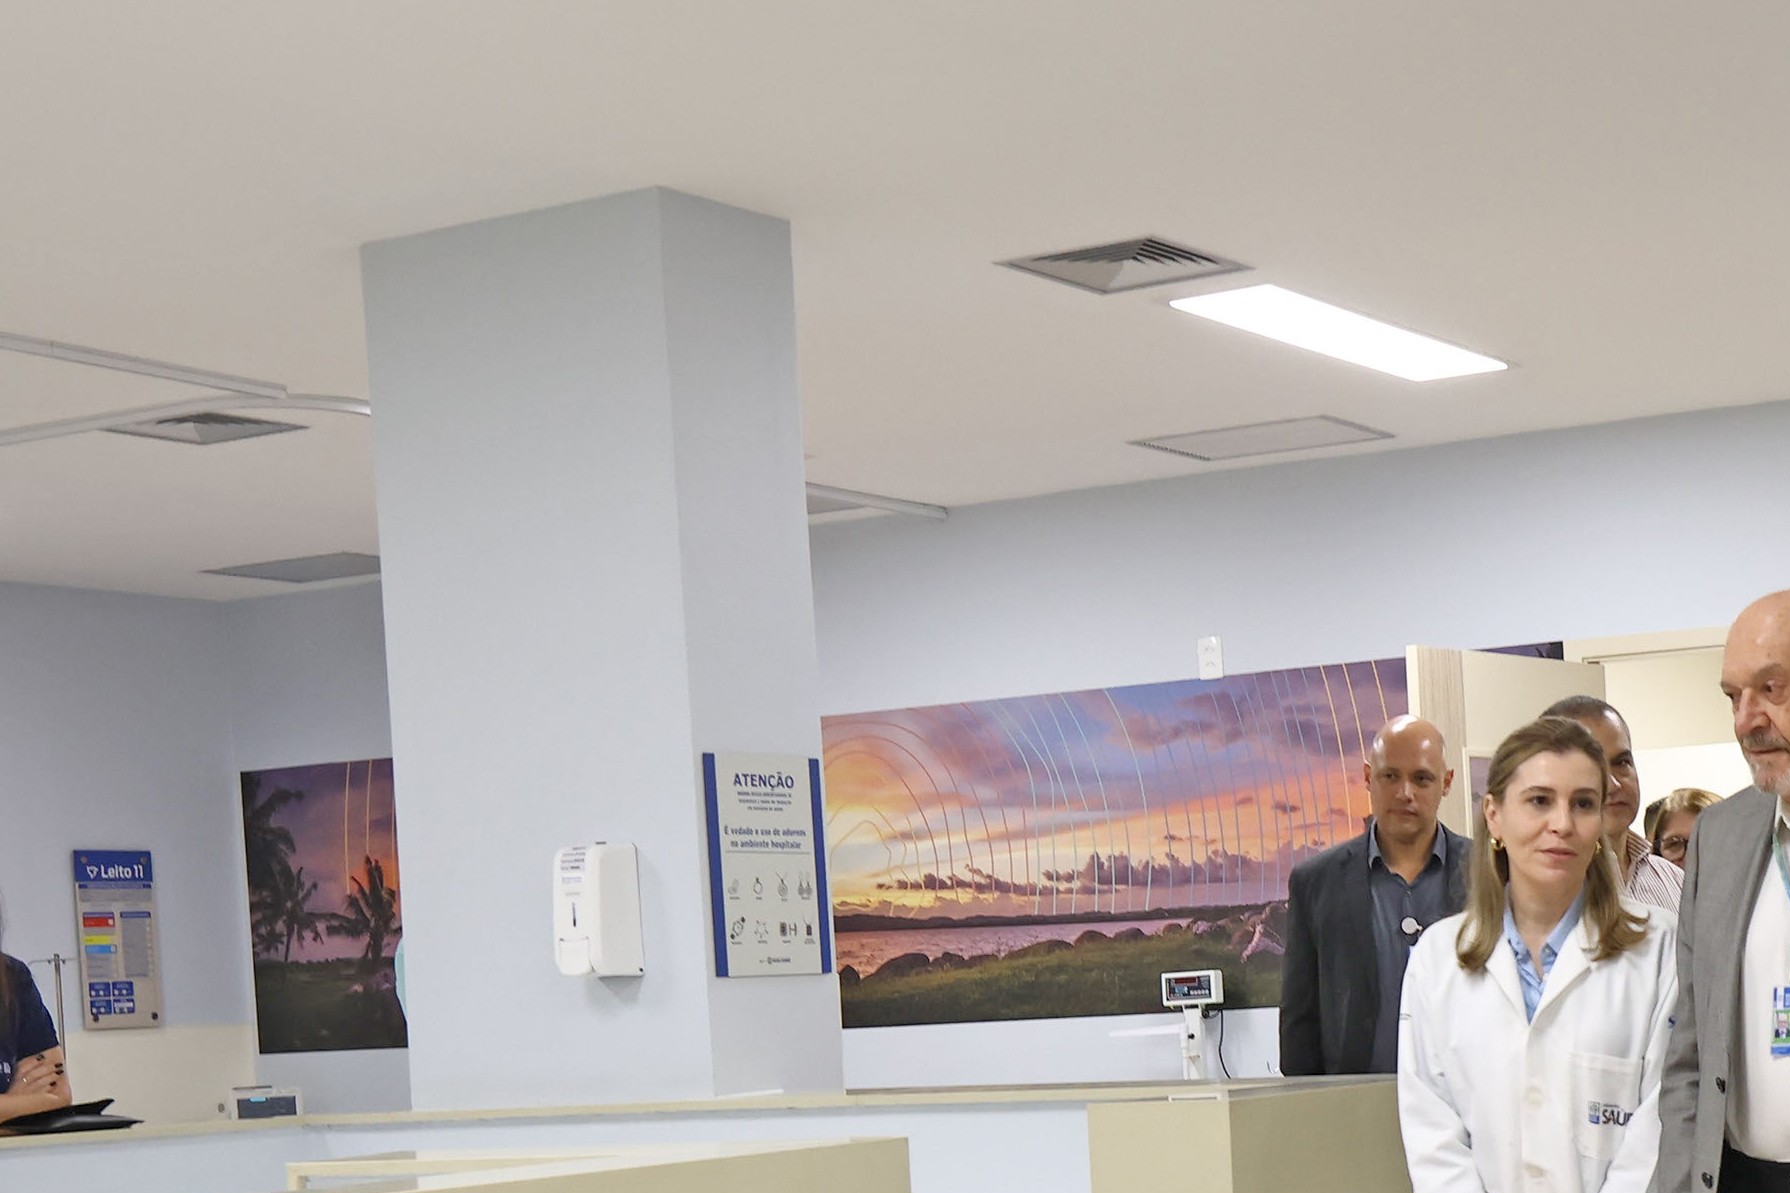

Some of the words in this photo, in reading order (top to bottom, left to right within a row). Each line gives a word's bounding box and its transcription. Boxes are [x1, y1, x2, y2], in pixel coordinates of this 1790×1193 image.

[733, 771, 795, 791] ATENÇÃO
[101, 864, 132, 879] Leito
[133, 864, 144, 879] 11
